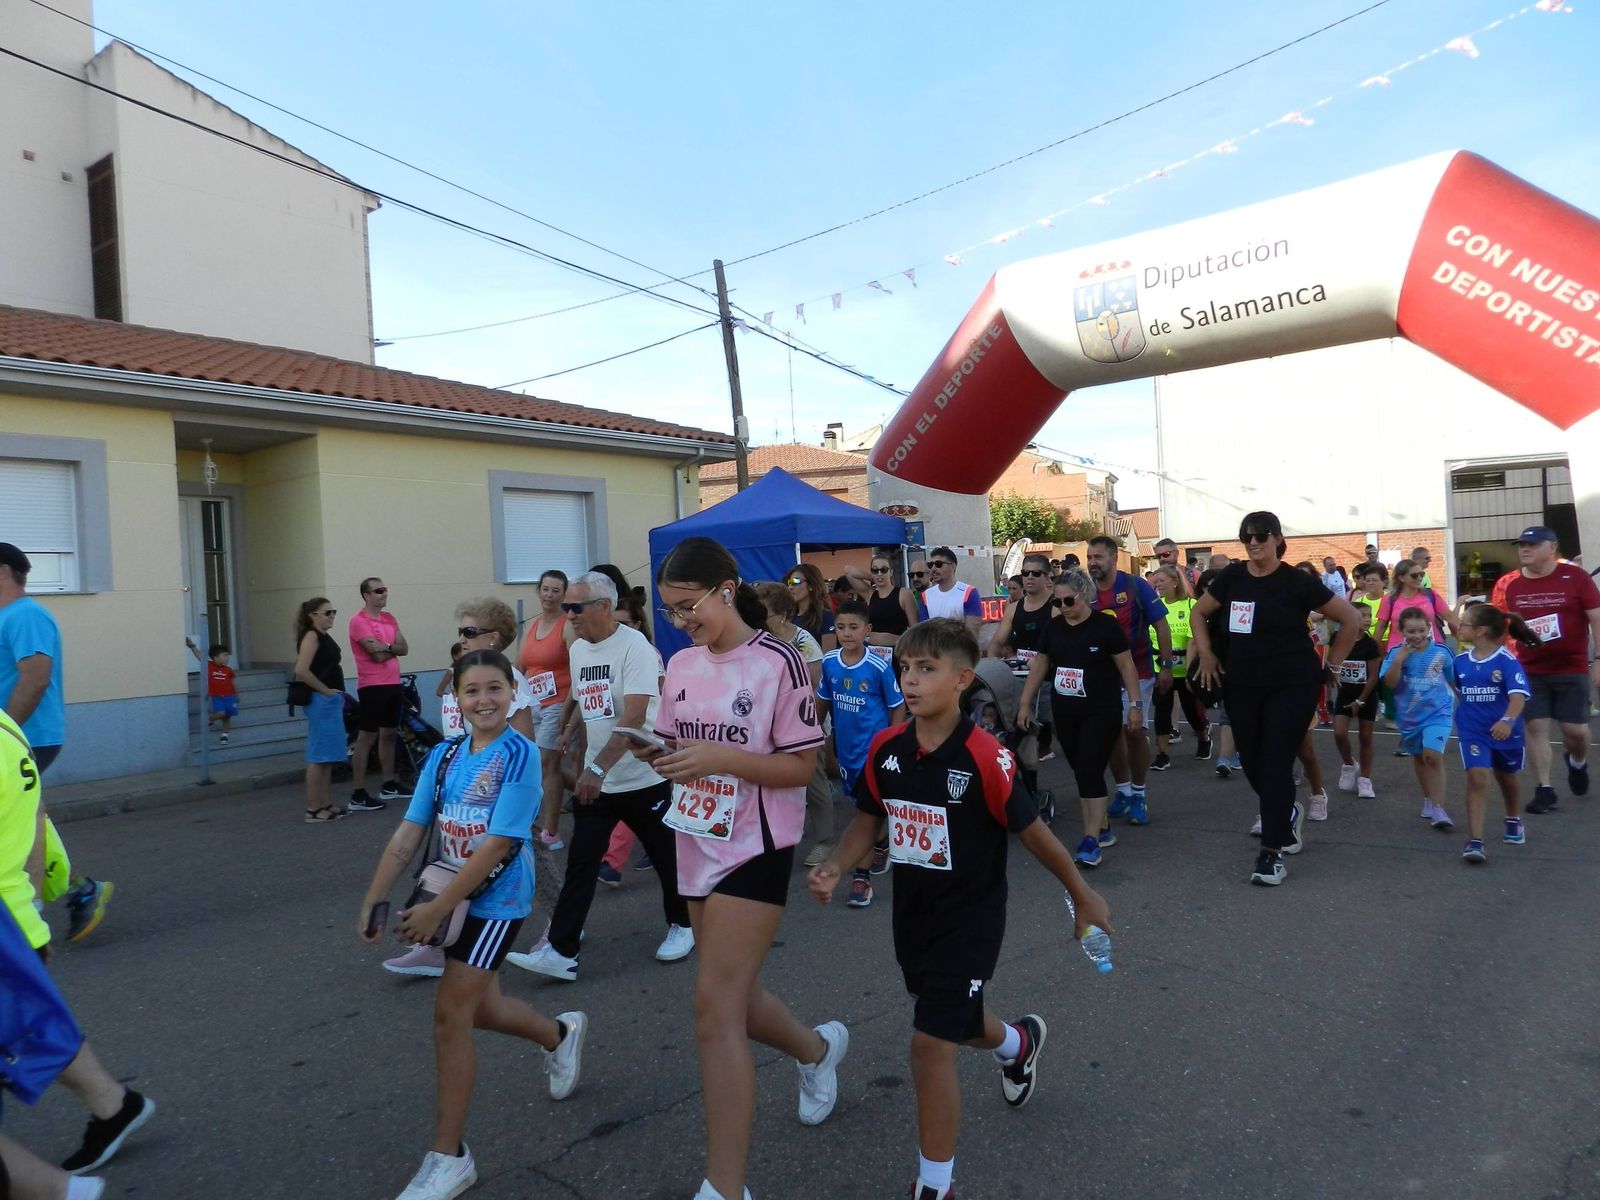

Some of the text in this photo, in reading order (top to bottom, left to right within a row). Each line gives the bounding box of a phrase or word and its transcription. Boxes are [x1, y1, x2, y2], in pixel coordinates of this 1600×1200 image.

[1144, 237, 1289, 289] Diputación
[1446, 224, 1600, 321] CON NUES
[1149, 284, 1327, 337] de Salamanca
[886, 321, 1003, 472] CON EL DEPORTE
[580, 664, 610, 682] PUMA
[1060, 677, 1077, 690] 450
[584, 694, 604, 711] 408
[832, 691, 866, 706] Emirates
[1461, 685, 1500, 695] Emirates
[677, 790, 717, 821] 429
[893, 821, 932, 851] 396
